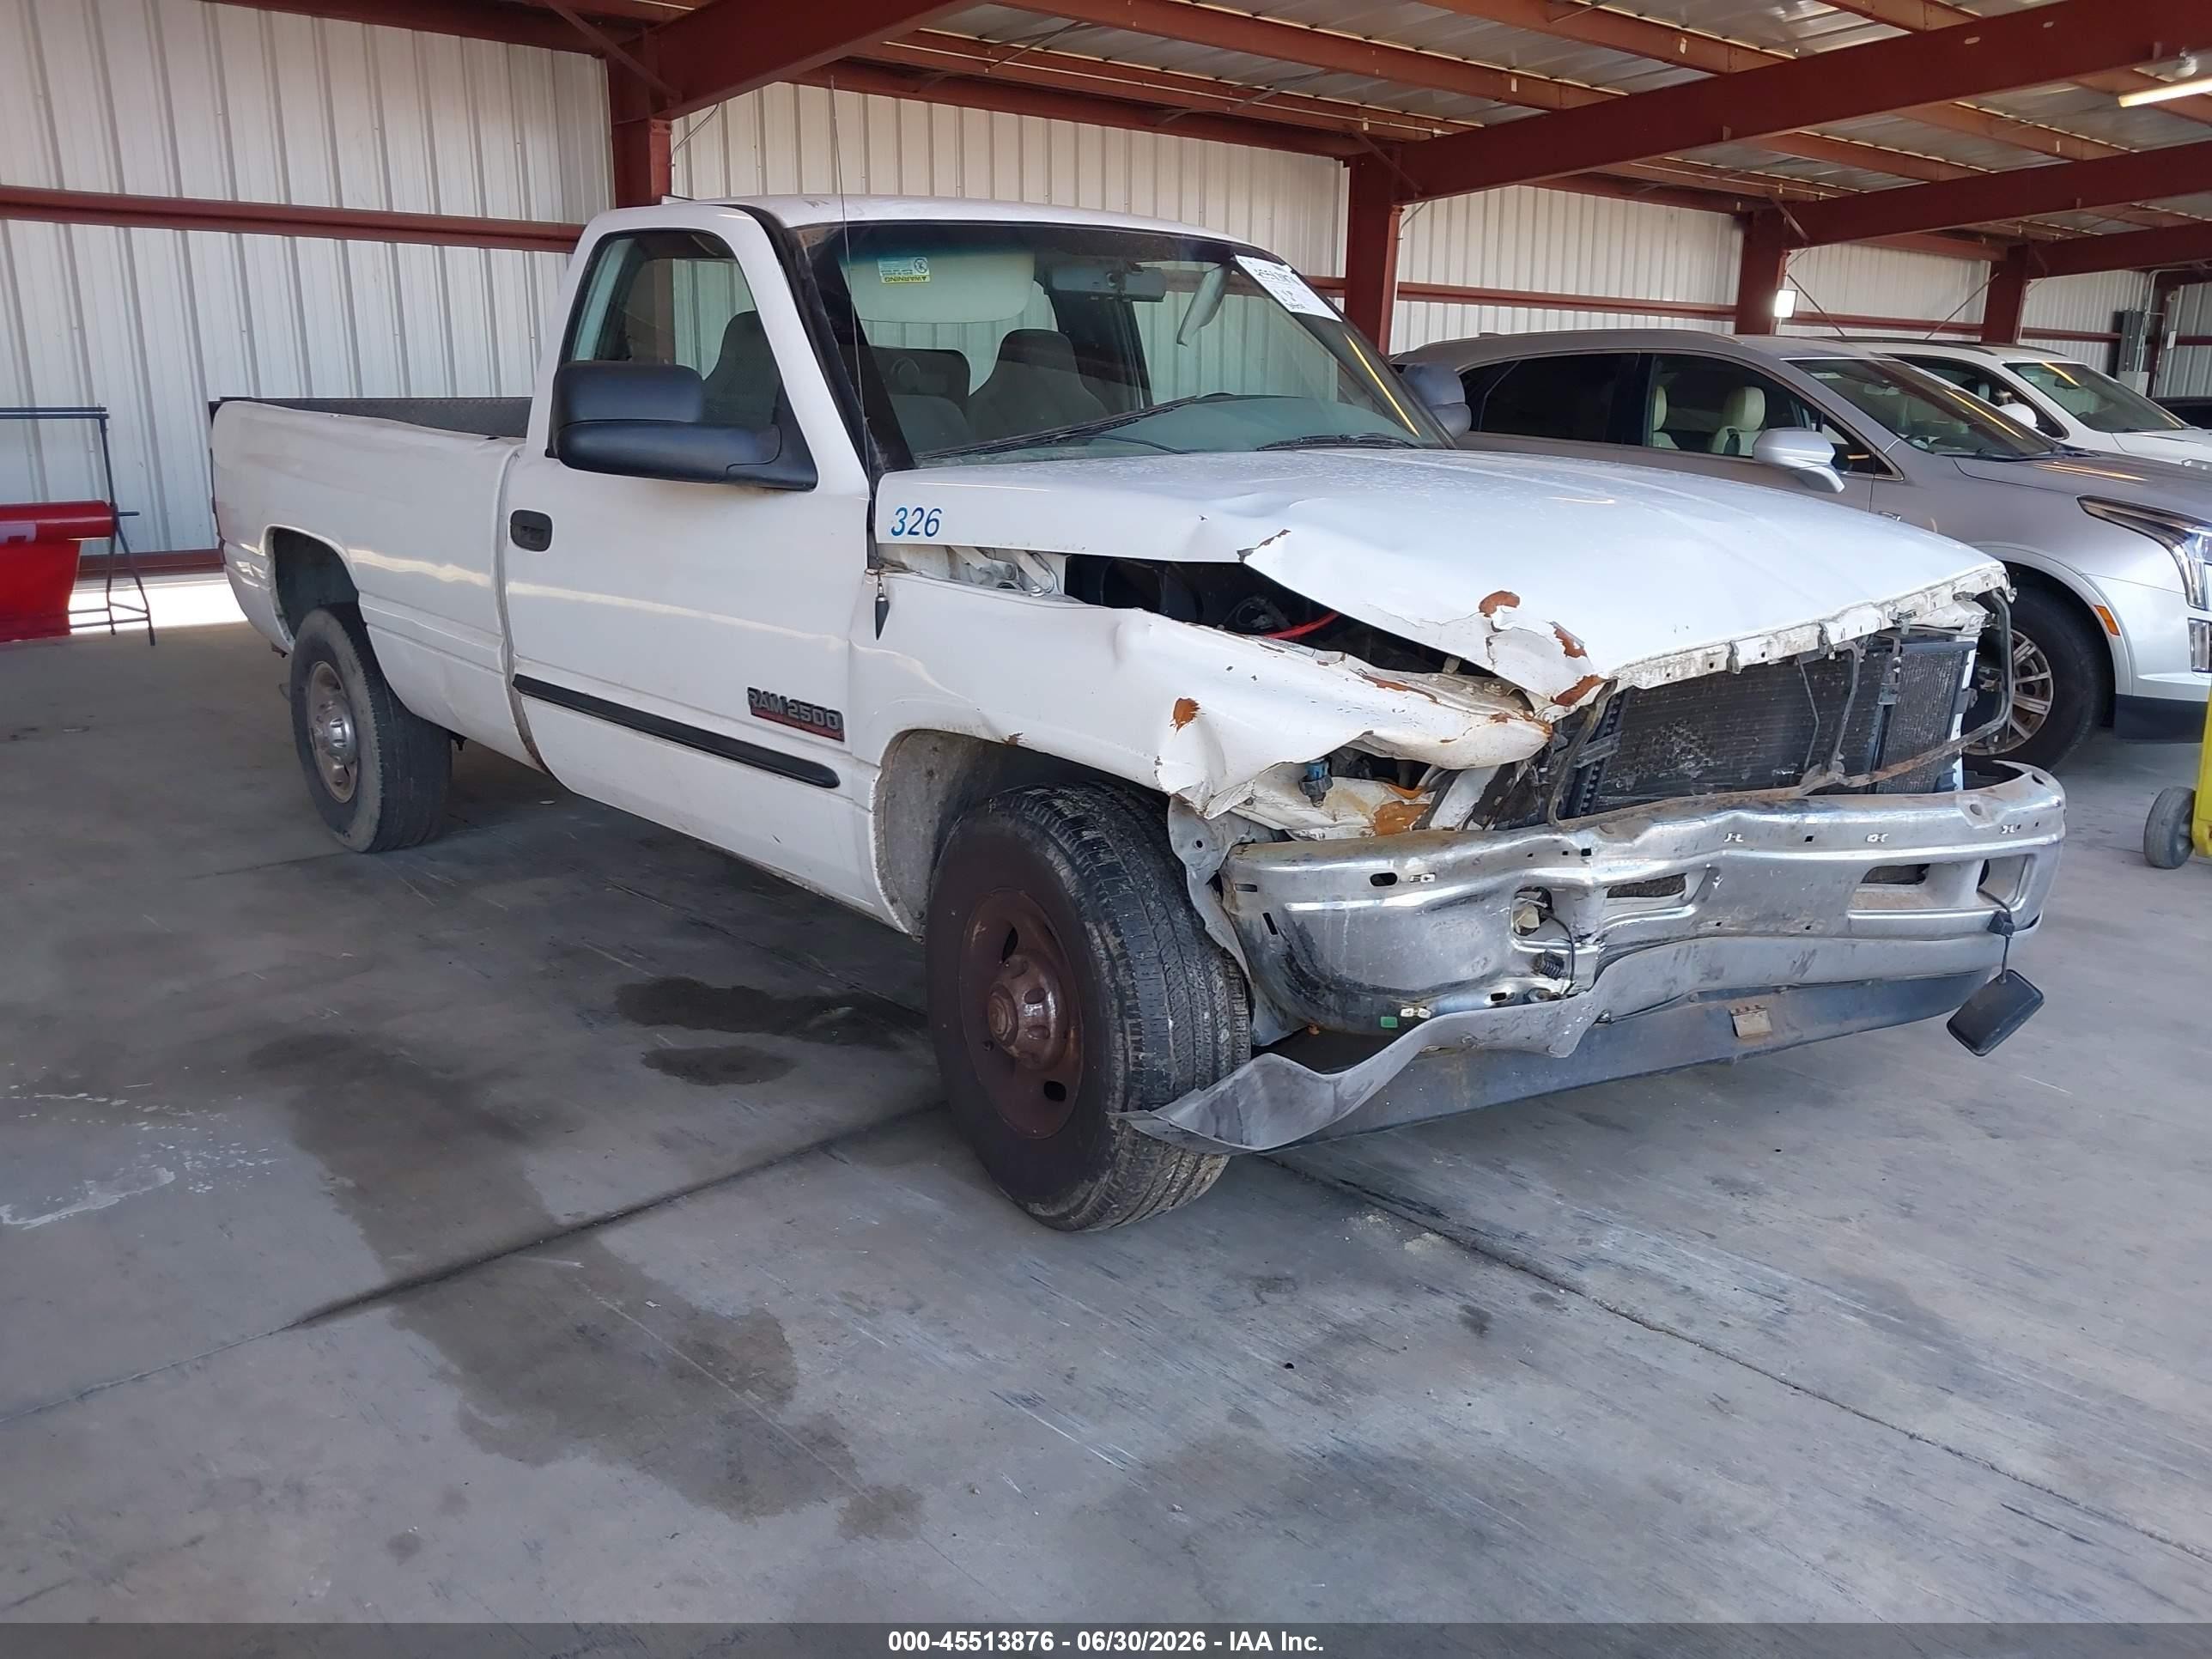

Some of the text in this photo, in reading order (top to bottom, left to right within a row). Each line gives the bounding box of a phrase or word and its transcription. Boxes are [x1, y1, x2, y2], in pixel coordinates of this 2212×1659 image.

[890, 507, 943, 538] 326
[747, 687, 843, 731] RAM 2500
